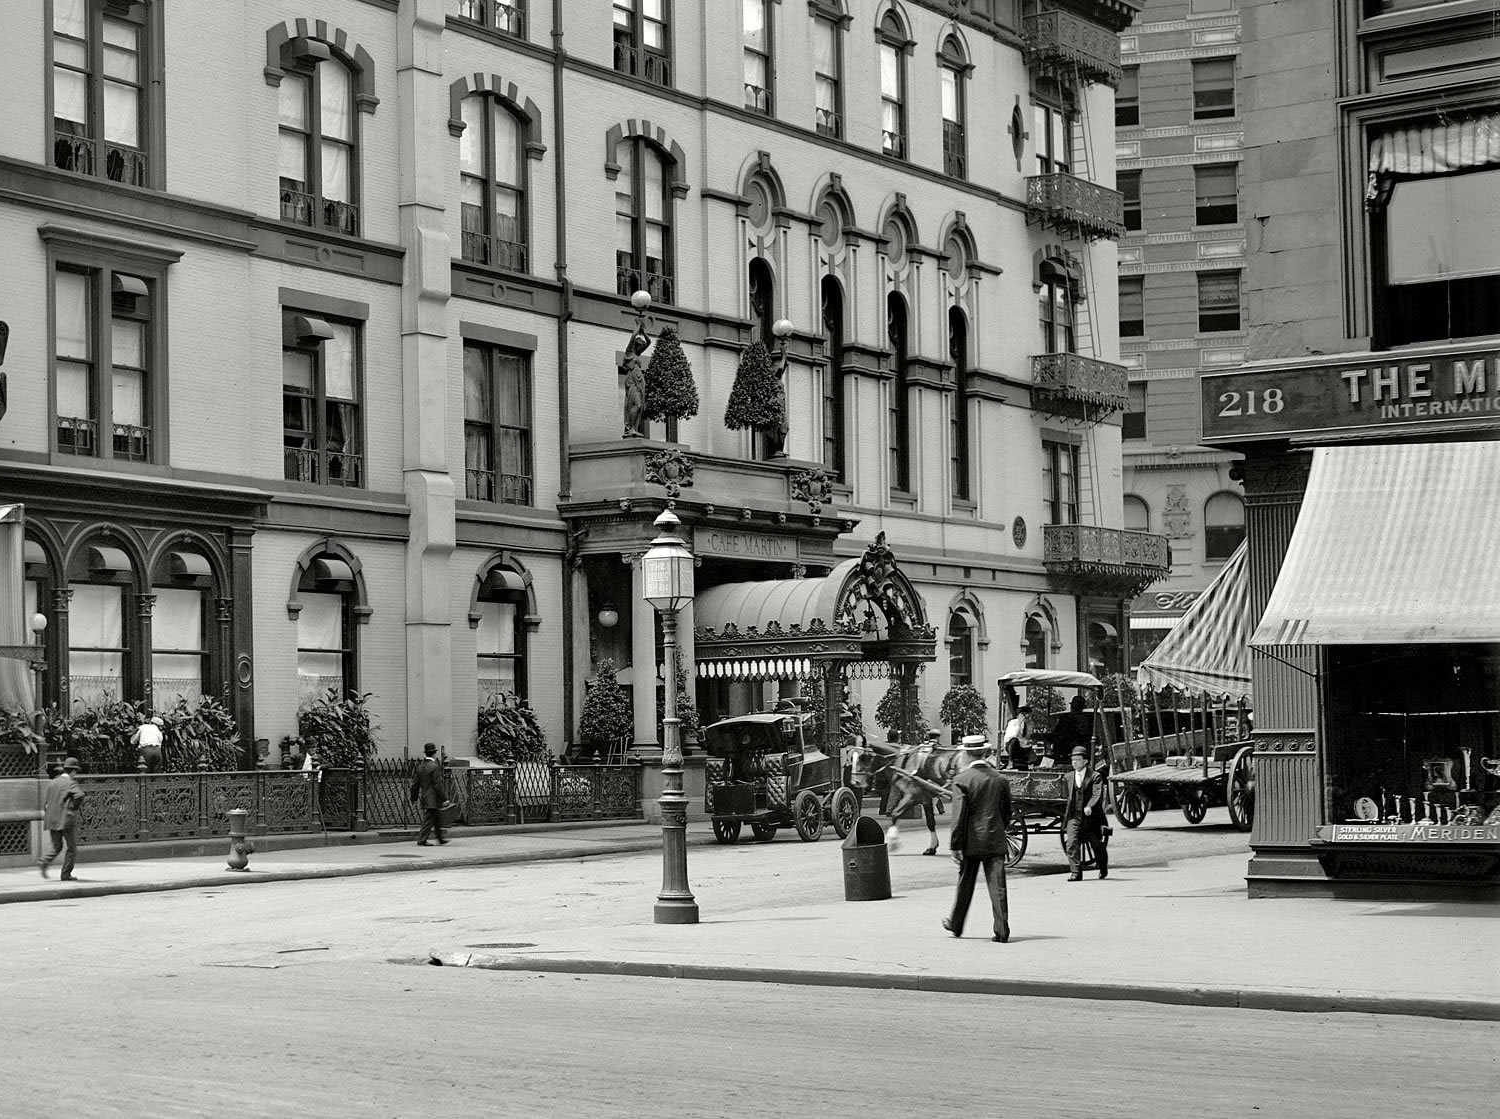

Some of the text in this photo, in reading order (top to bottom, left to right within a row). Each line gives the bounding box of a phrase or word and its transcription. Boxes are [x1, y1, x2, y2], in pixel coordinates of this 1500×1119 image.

[1340, 357, 1500, 403] THE M
[1217, 388, 1285, 417] 218
[744, 536, 784, 556] MARTIN
[1410, 826, 1499, 841] MERIDEN
